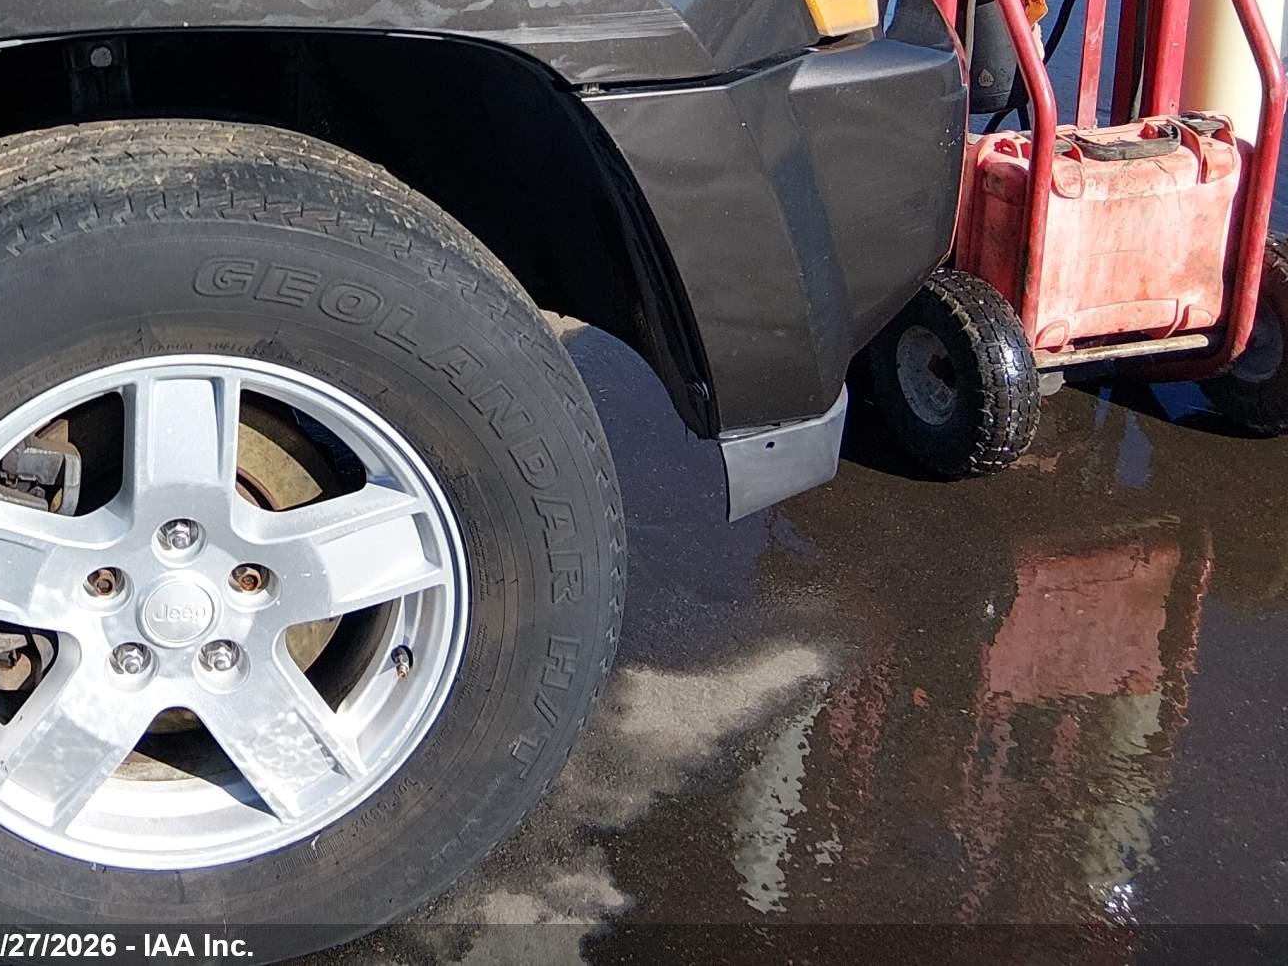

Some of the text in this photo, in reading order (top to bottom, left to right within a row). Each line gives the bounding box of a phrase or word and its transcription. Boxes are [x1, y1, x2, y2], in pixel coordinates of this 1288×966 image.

[152, 601, 207, 624] Jeep
[193, 257, 588, 605] GEOLANDAR
[511, 634, 583, 781] H/T
